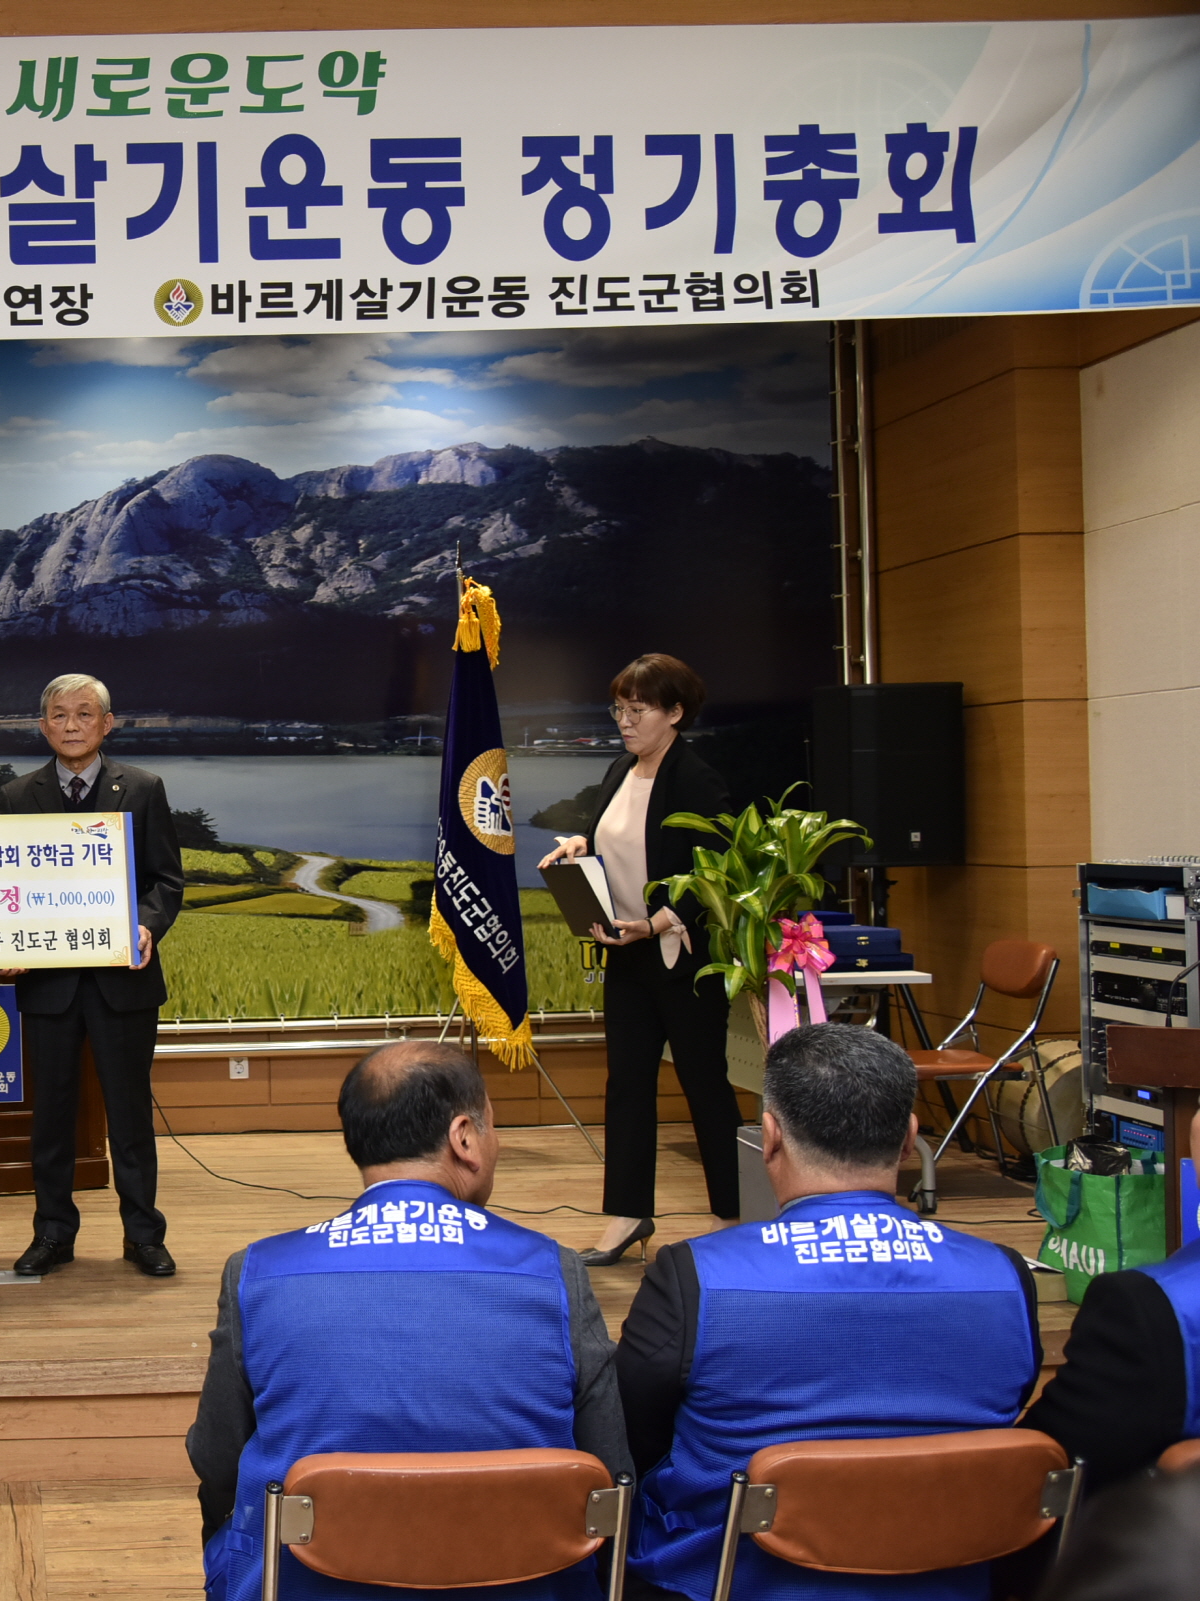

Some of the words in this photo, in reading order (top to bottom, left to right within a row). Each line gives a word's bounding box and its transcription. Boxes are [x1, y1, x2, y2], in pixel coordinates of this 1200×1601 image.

[6, 50, 388, 120] 새로운도약
[522, 122, 978, 262] 정기총회
[211, 275, 530, 323] 바르게살기운동
[548, 268, 821, 316] 진도군협의회
[26, 843, 75, 868] 장학금
[81, 843, 113, 866] 기탁
[10, 929, 58, 952] 진도군
[64, 927, 112, 951] 협의회
[305, 1200, 489, 1235] 바르게살기운동
[761, 1213, 944, 1246] 바르게살기운동
[328, 1222, 464, 1248] 진도군협의회
[794, 1238, 934, 1264] 진도군협의회
